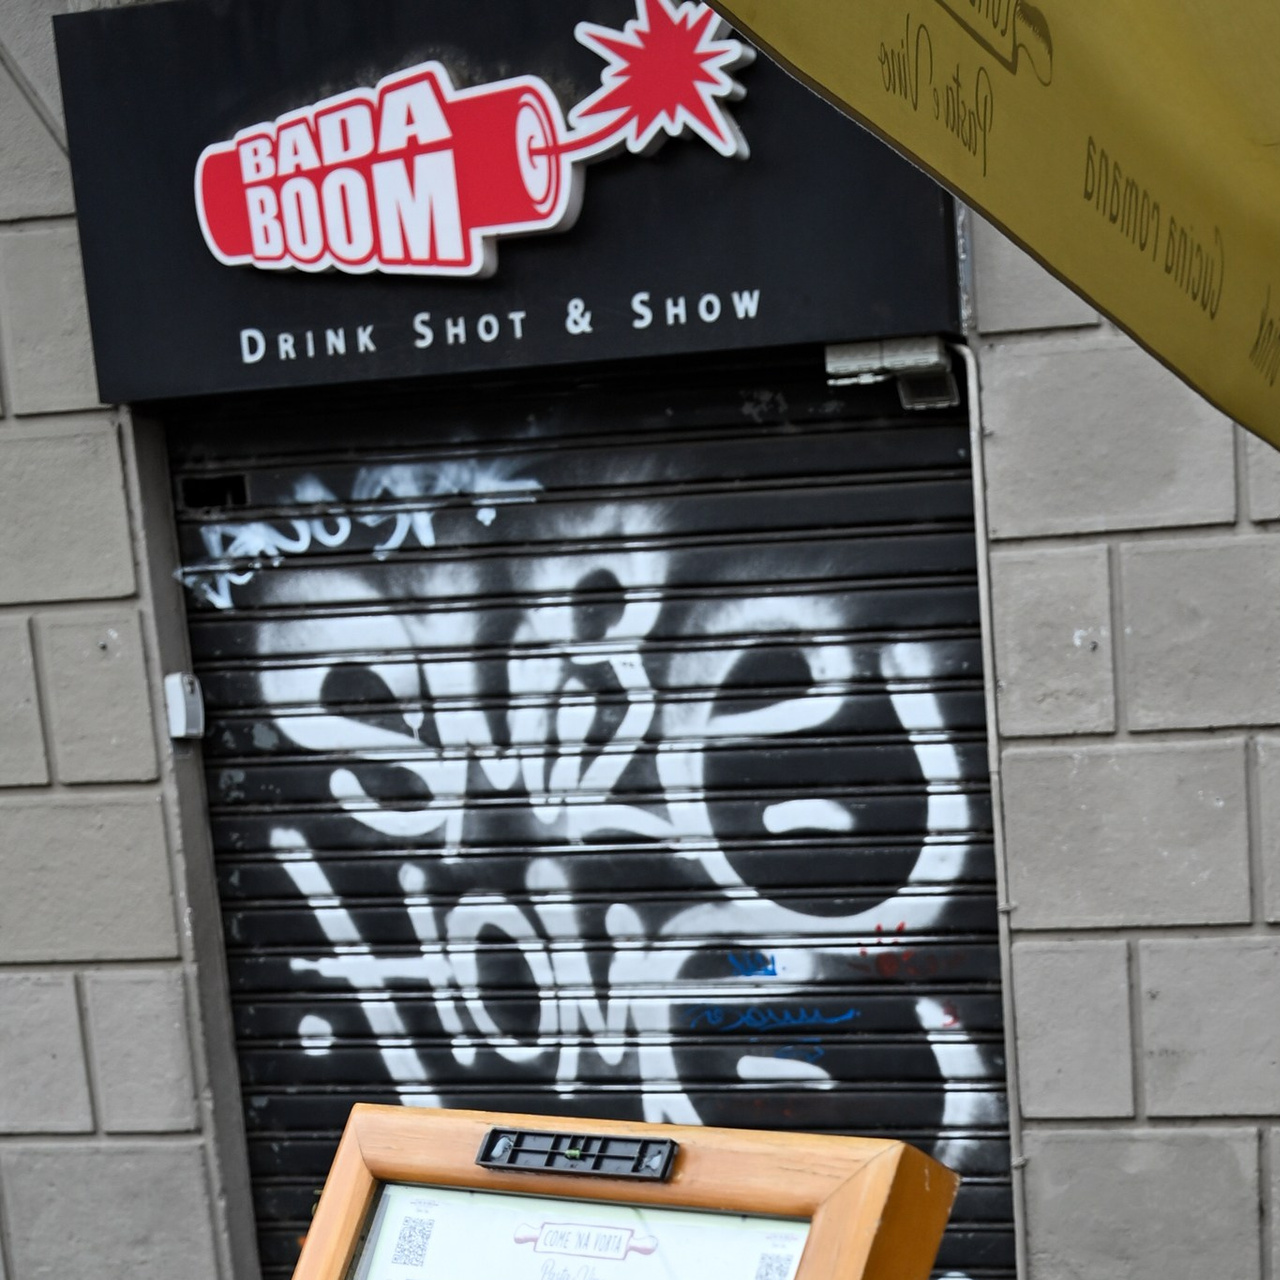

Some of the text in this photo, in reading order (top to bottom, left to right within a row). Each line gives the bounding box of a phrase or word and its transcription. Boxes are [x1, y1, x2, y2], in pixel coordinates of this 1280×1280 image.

[239, 66, 454, 183] BADA
[245, 151, 466, 263] BOOM
[564, 298, 593, 335] &
[543, 1230, 570, 1249] COME
